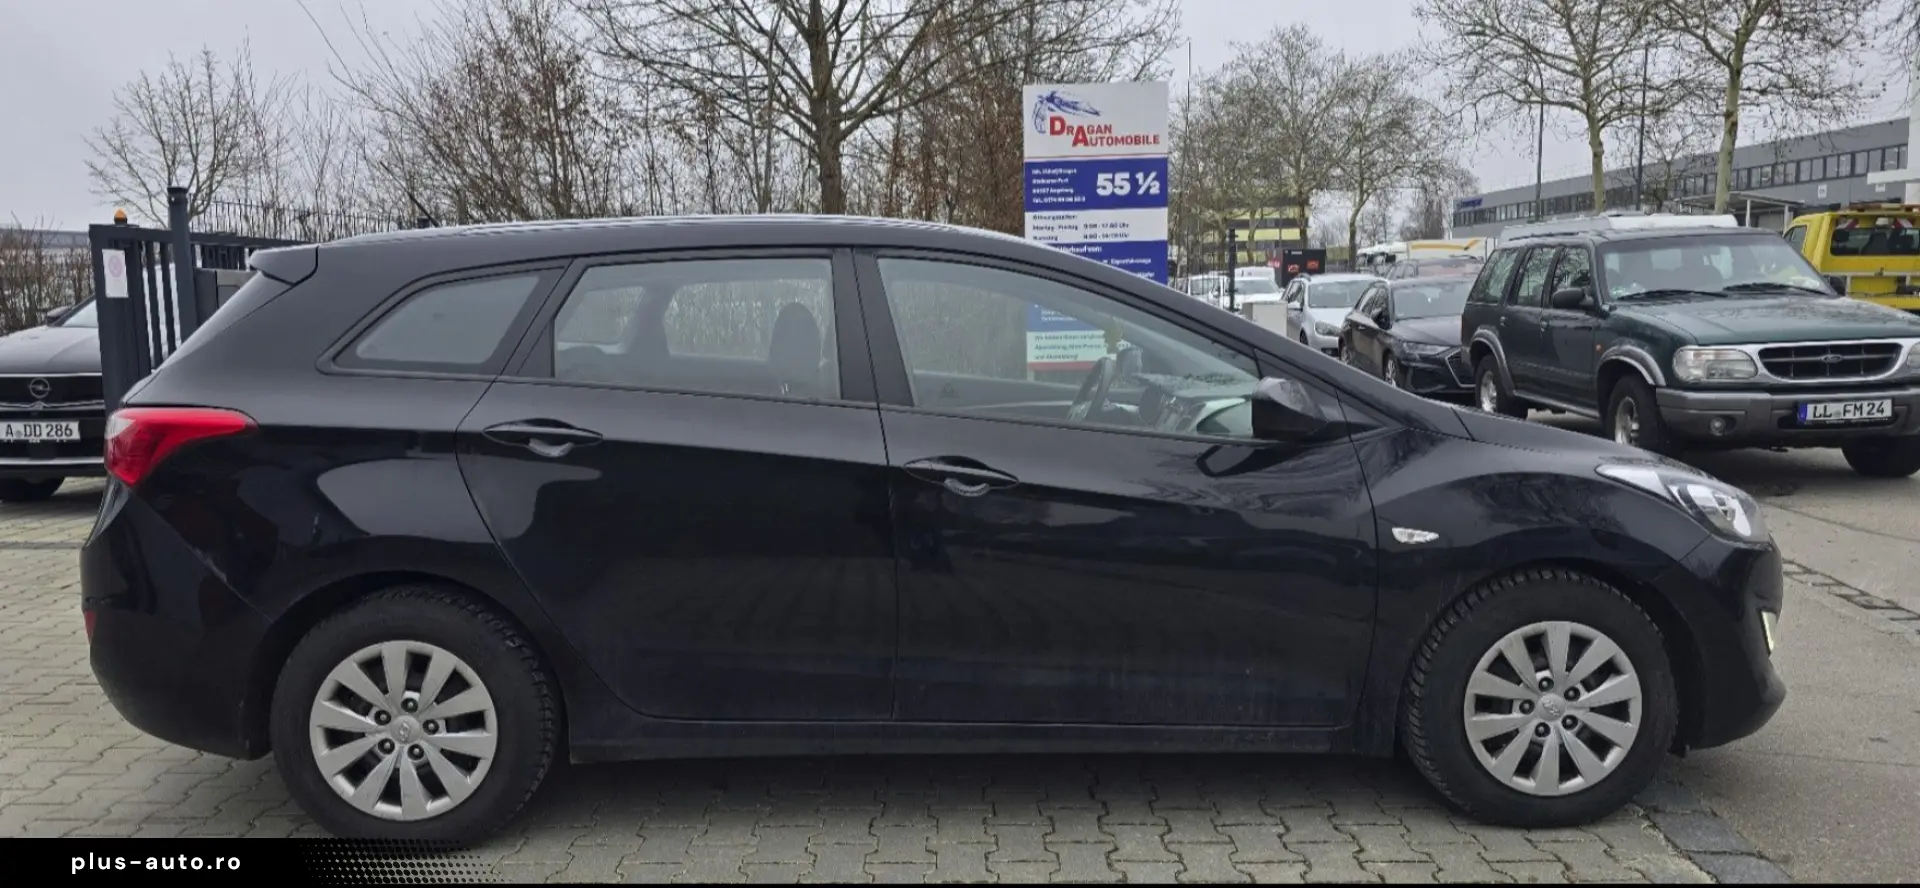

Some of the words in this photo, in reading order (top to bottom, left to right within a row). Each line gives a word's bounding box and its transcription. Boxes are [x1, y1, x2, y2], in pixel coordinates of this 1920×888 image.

[1072, 125, 1160, 147] AUTOMOBILE
[1096, 172, 1131, 196] 55
[1812, 405, 1832, 419] LL
[1843, 403, 1863, 417] FM
[1866, 402, 1884, 416] 24
[5, 424, 13, 437] A
[23, 424, 42, 437] DD
[45, 424, 73, 437] 286
